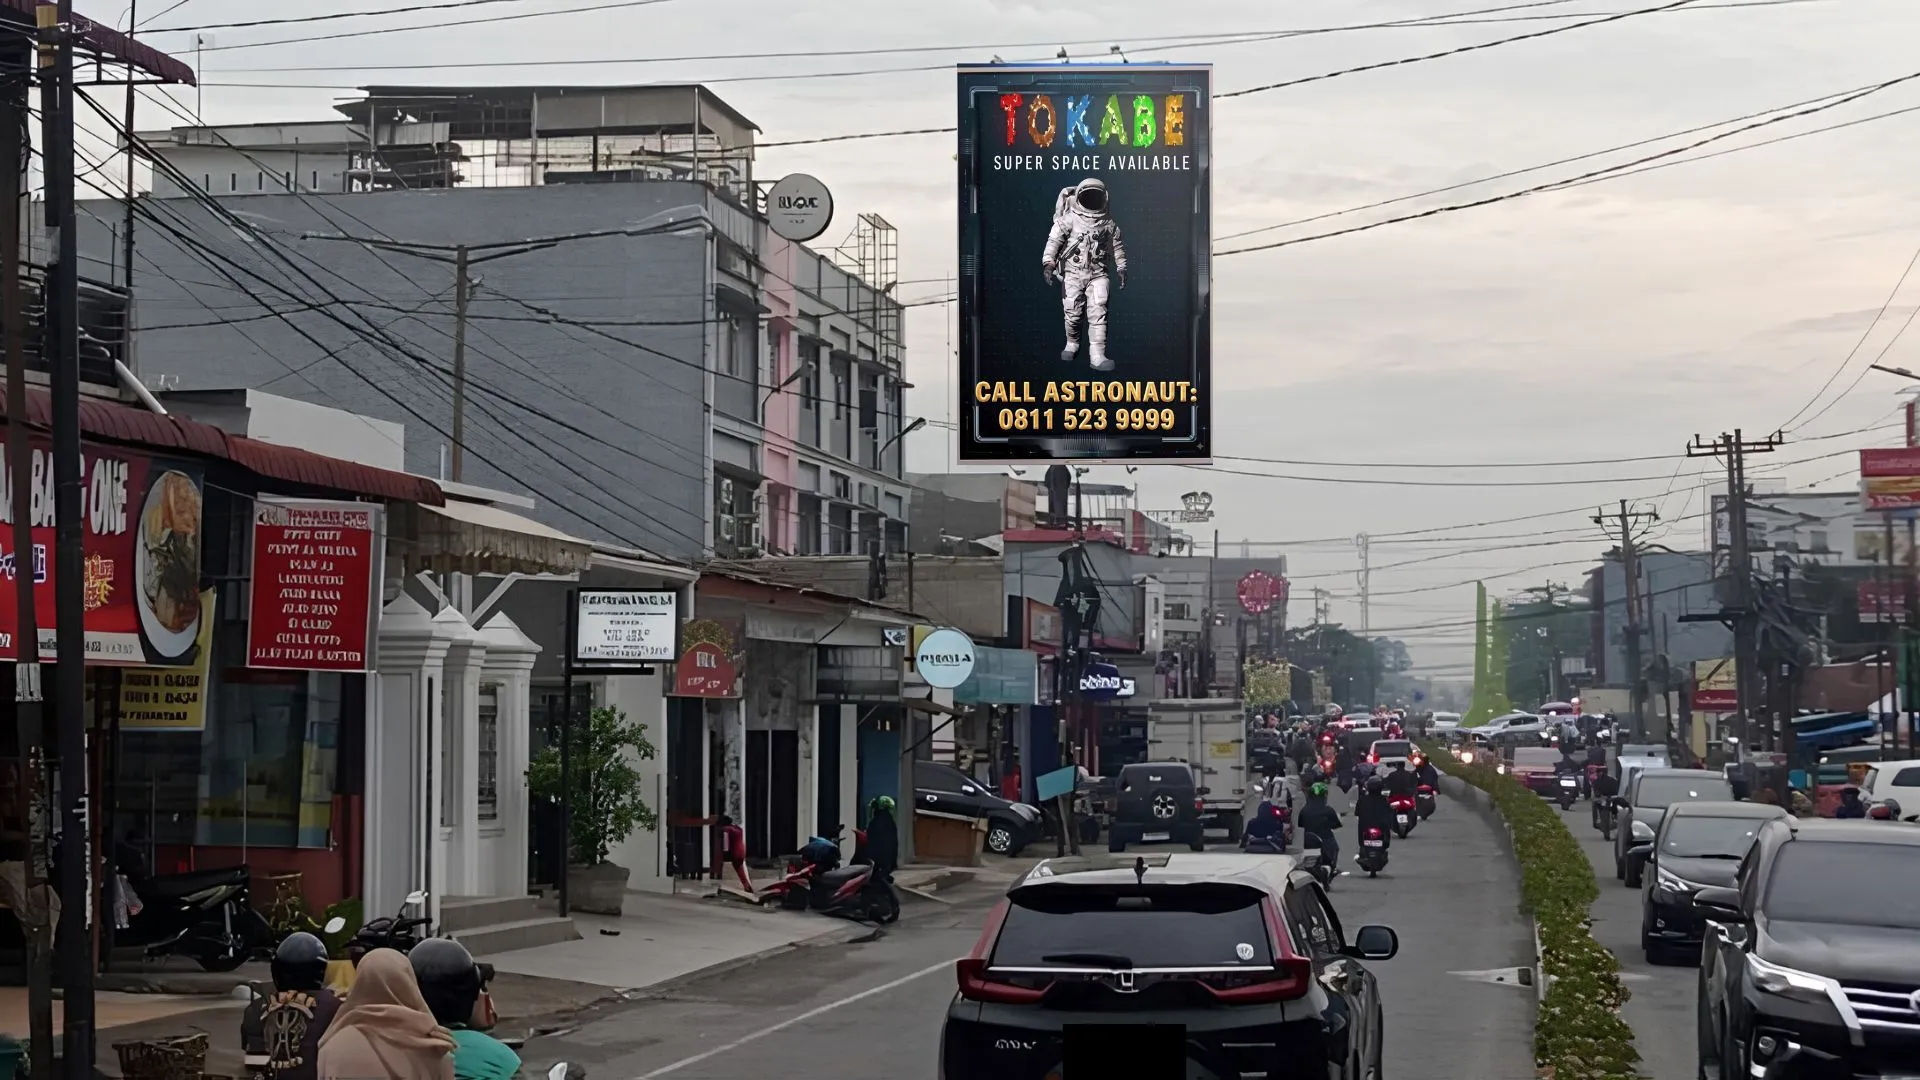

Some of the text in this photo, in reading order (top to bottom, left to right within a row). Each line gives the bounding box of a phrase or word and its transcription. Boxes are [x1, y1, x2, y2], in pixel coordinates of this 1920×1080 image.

[1000, 93, 1184, 148] TOKABE
[993, 155, 1190, 170] SUPER SPACE AVAILABLE
[975, 381, 1198, 402] CALL ASTRONAUT:
[999, 408, 1176, 431] 0811 523 9999
